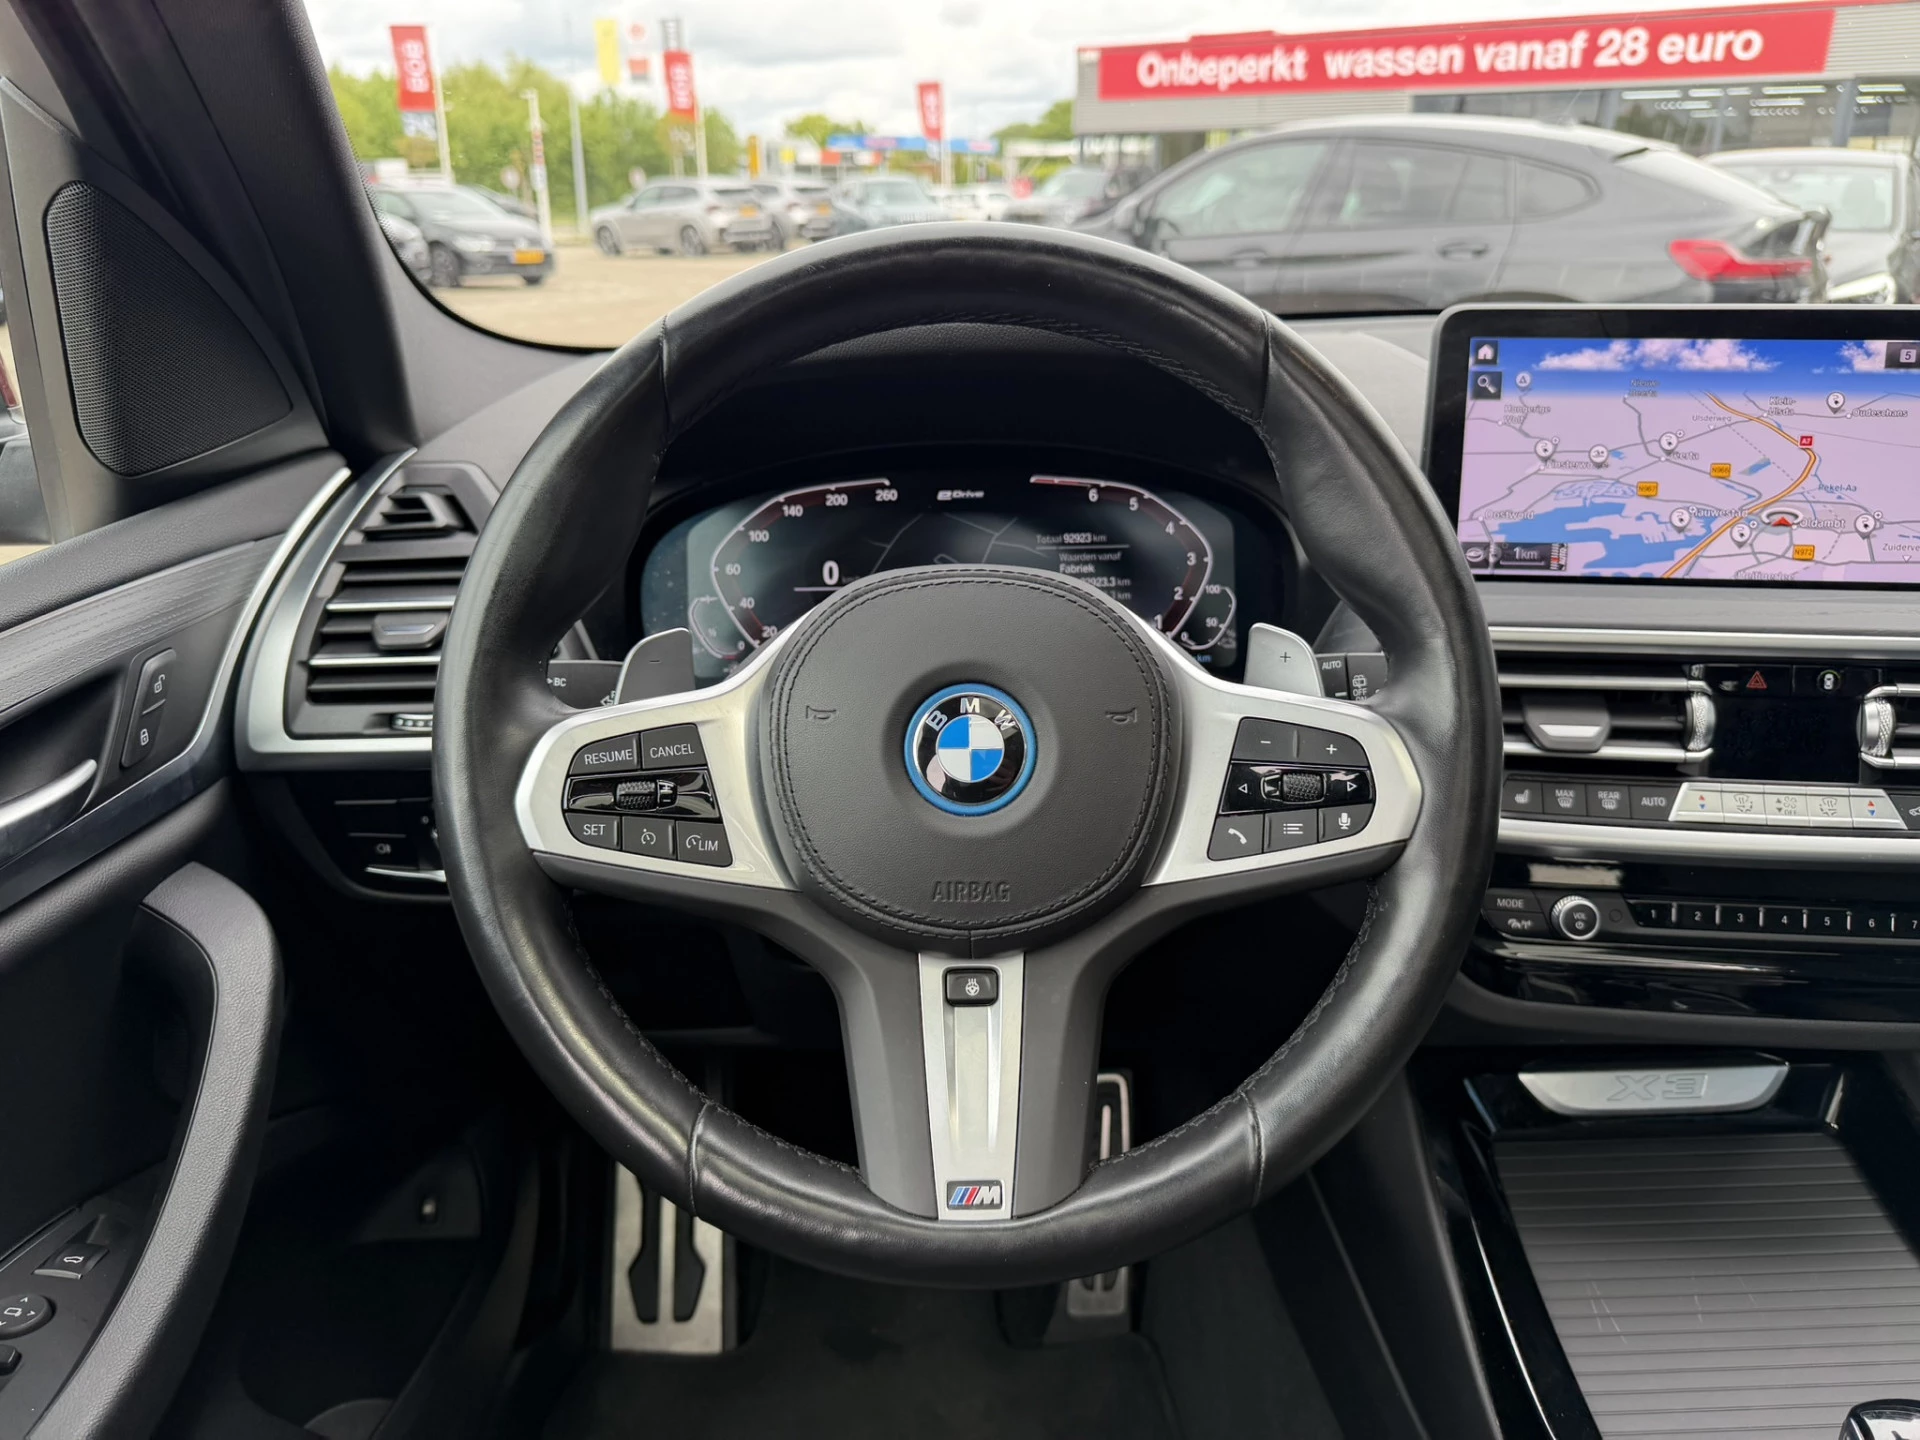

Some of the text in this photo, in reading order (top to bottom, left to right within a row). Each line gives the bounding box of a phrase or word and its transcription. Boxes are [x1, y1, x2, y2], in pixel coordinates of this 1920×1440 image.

[1136, 26, 1763, 91] Onbeperkt wassen vanaf 28 euro
[1904, 351, 1911, 360] 5
[1852, 408, 1908, 418] Oudeschans
[1801, 438, 1811, 446] A7
[825, 494, 848, 506] 200
[876, 489, 898, 501] 260
[1089, 489, 1099, 502] 6
[1129, 498, 1139, 511] 5
[782, 505, 803, 517] 140
[1165, 521, 1175, 534] 4
[1800, 520, 1845, 529] Oldambt
[749, 530, 769, 542] 100
[1063, 532, 1092, 544] 92923
[1093, 534, 1107, 542] km
[1059, 551, 1121, 561] Waarden vanaf
[1187, 553, 1196, 565] 3
[725, 564, 741, 575] 60
[822, 560, 839, 585] 0
[1060, 563, 1095, 574] Fabriek
[1117, 578, 1131, 586] km
[1174, 586, 1184, 600] 2
[1206, 584, 1220, 594] 100
[1117, 591, 1131, 599] km
[740, 597, 755, 609] 40
[1154, 614, 1164, 630] 1
[1206, 617, 1218, 627] 50
[762, 626, 777, 638] 20
[1181, 632, 1188, 641] 0
[737, 641, 745, 651] 0
[1322, 661, 1341, 670] AUTO
[553, 677, 567, 687] BC
[1352, 688, 1367, 697] OFF
[926, 697, 1019, 732] BMW
[650, 744, 695, 759] CANCEL
[584, 749, 633, 765] RESUME
[1555, 789, 1574, 798] MAX
[1598, 791, 1619, 800] REAR
[1641, 797, 1665, 807] AUTO
[583, 824, 605, 836] SET
[699, 839, 719, 852] LIM
[932, 880, 1010, 903] AIRBAG
[1497, 899, 1524, 908] MODE
[1573, 912, 1587, 920] VOL
[1651, 909, 1656, 919] 1
[1694, 911, 1701, 921] 2
[1737, 913, 1744, 923] 3
[1781, 915, 1788, 925] 4
[1824, 917, 1831, 926] 5
[1868, 919, 1875, 928] 6
[1911, 920, 1918, 930] 7
[1606, 1072, 1709, 1101] X3
[974, 1185, 1001, 1205] M
